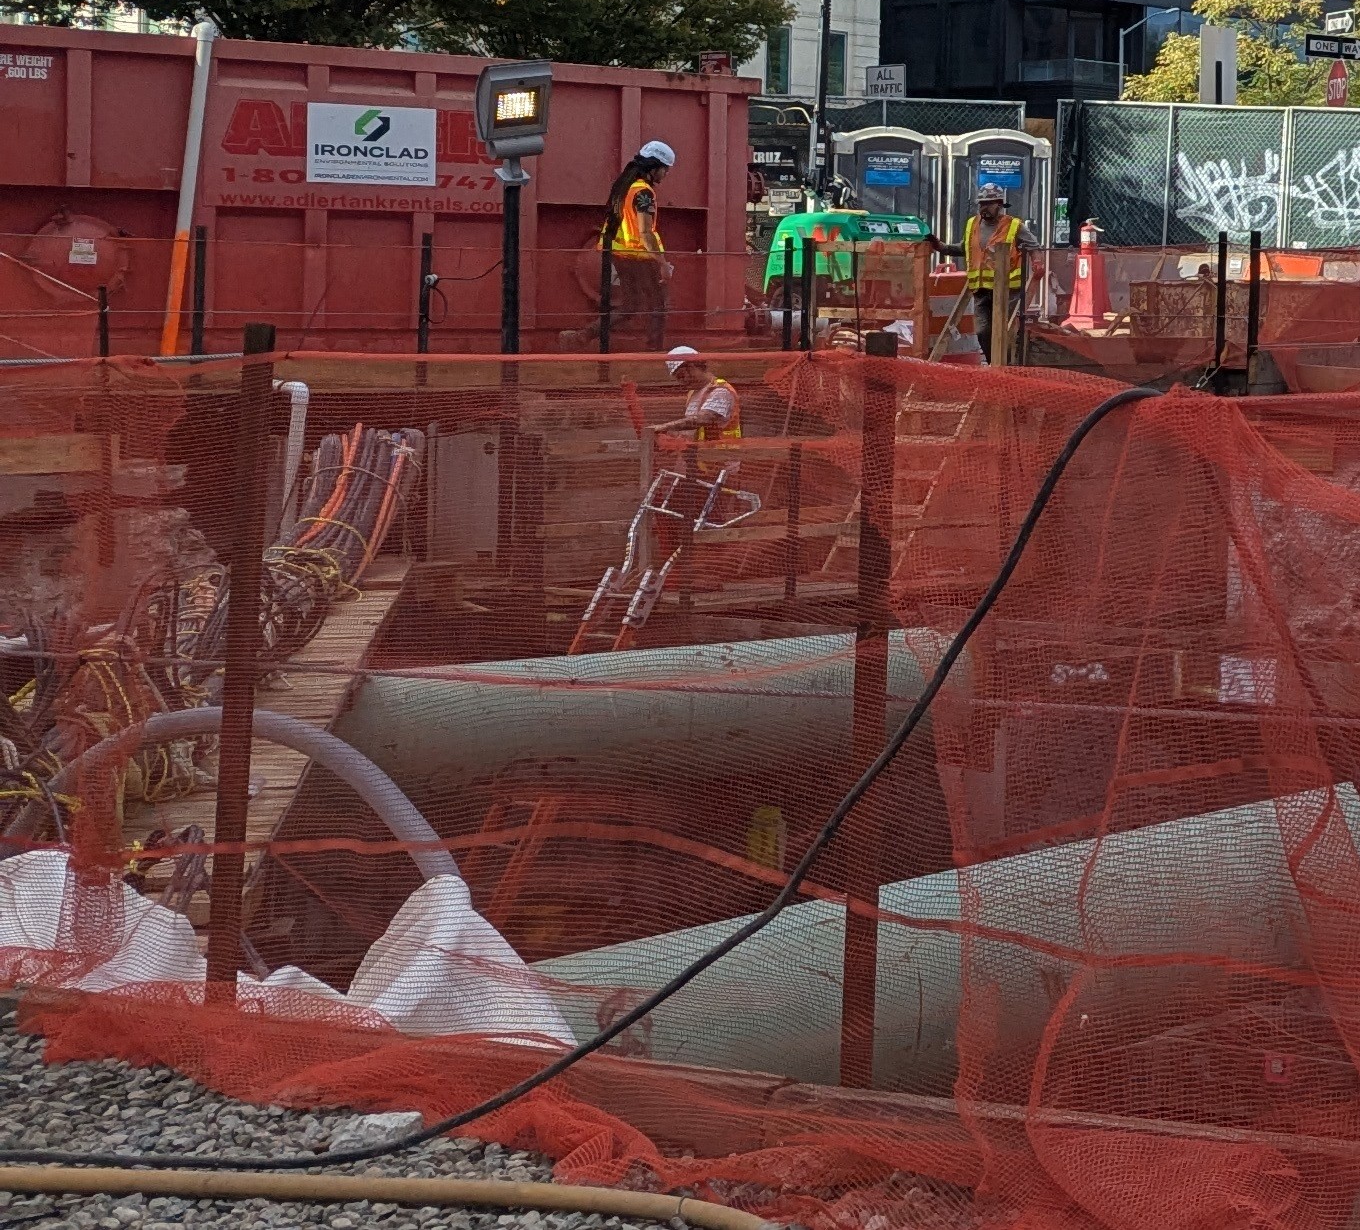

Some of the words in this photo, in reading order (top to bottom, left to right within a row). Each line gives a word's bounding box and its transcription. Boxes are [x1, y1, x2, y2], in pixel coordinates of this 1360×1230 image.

[1315, 41, 1336, 52] ONE
[16, 55, 53, 67] WEIGHT
[28, 68, 48, 80] LBS
[876, 68, 895, 81] ALL
[869, 82, 903, 95] TRAFFIC
[1328, 77, 1347, 101] STOP
[314, 143, 429, 160] IRONCLAD
[314, 158, 382, 167] ENVIRONMENTAL
[753, 152, 781, 164] CRUZ
